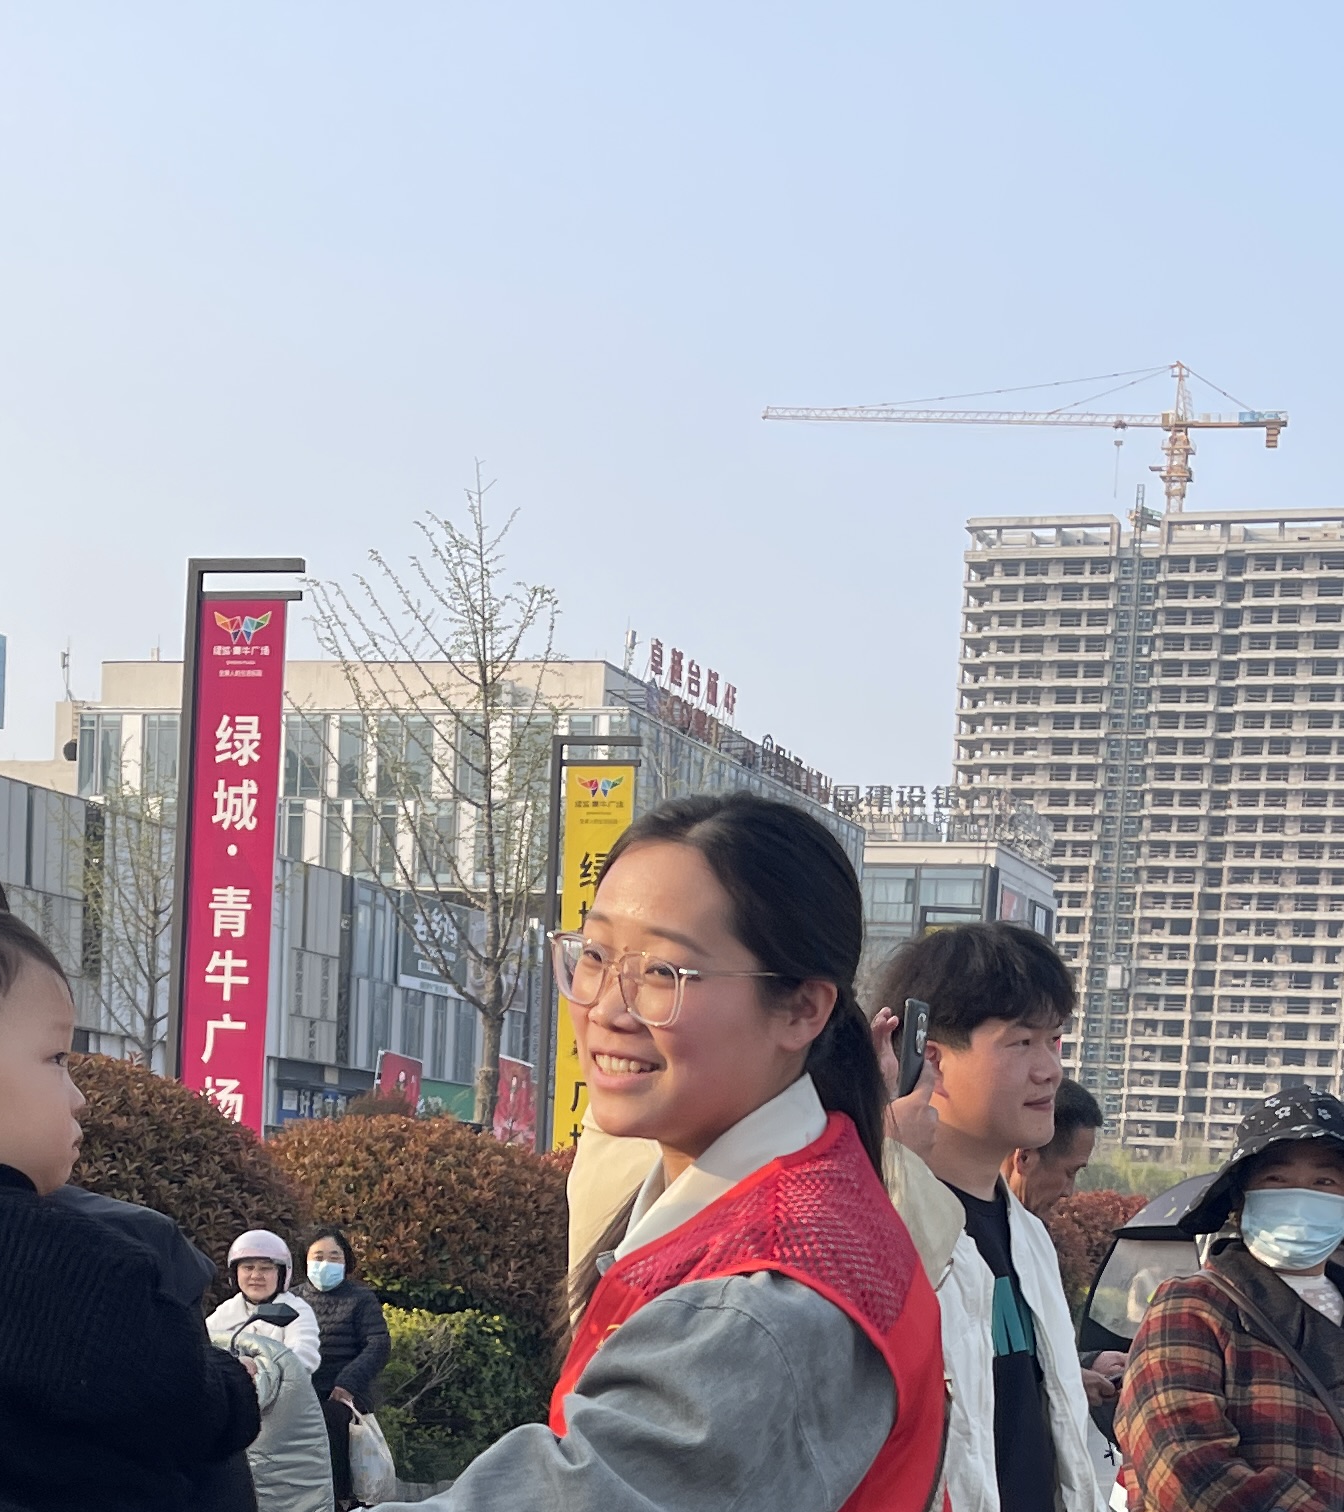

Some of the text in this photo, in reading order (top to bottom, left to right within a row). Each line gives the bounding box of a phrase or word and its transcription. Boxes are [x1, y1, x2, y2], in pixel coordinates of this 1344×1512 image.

[200, 714, 262, 1125] 绿城·青牛广场
